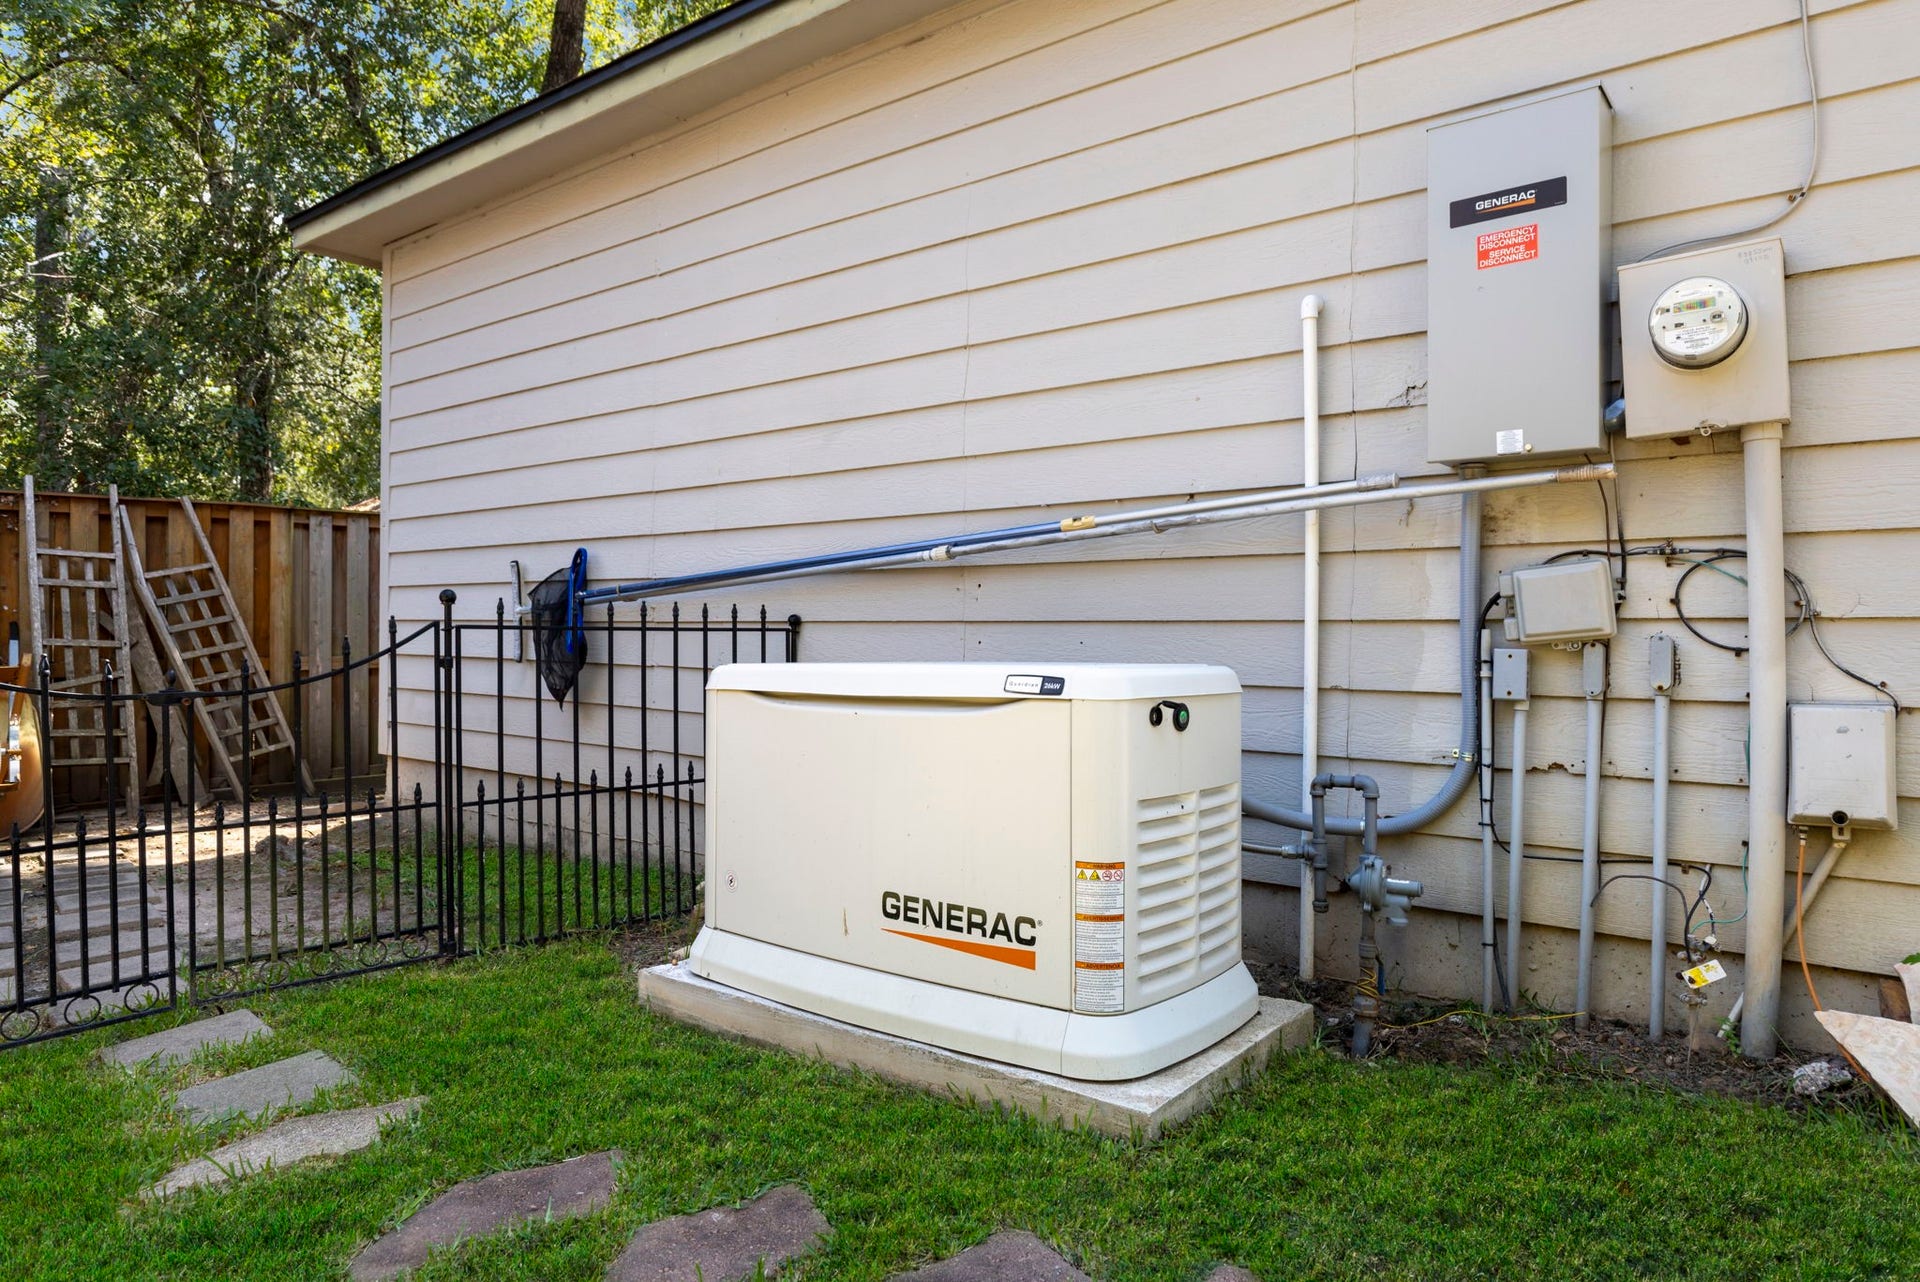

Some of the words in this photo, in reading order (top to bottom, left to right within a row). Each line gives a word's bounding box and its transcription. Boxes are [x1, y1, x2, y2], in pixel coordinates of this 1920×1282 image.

[1475, 189, 1536, 211] GENERAC
[1479, 232, 1536, 251] DISCONNECT
[1480, 225, 1535, 244] EMERGENCY
[1479, 249, 1536, 268] DISCONNECT
[1489, 244, 1526, 259] SERVICE
[881, 891, 1036, 947] GENERAC
